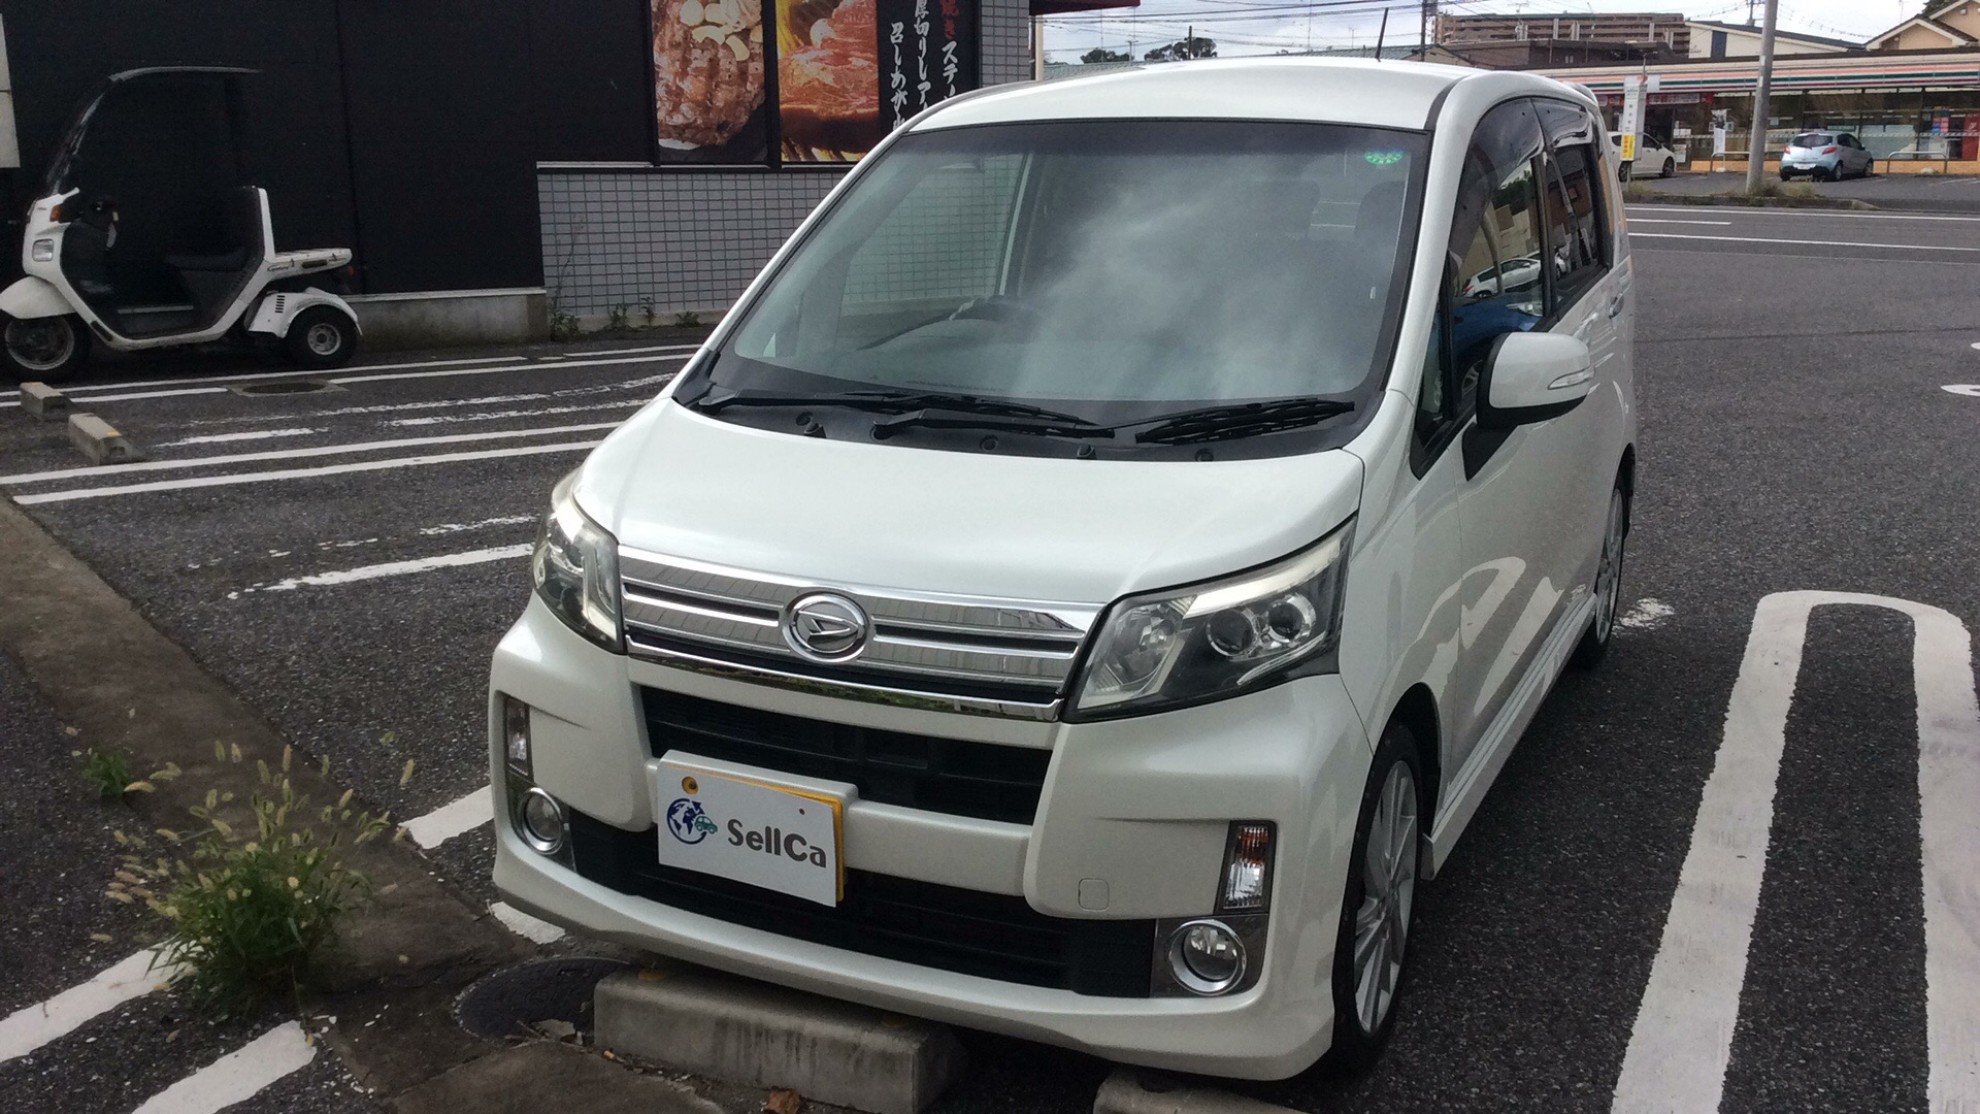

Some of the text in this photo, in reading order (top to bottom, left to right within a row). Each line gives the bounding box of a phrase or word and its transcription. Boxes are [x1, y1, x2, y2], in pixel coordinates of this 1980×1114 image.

[941, 0, 960, 101] 焼きステー
[727, 818, 827, 868] SellCa
